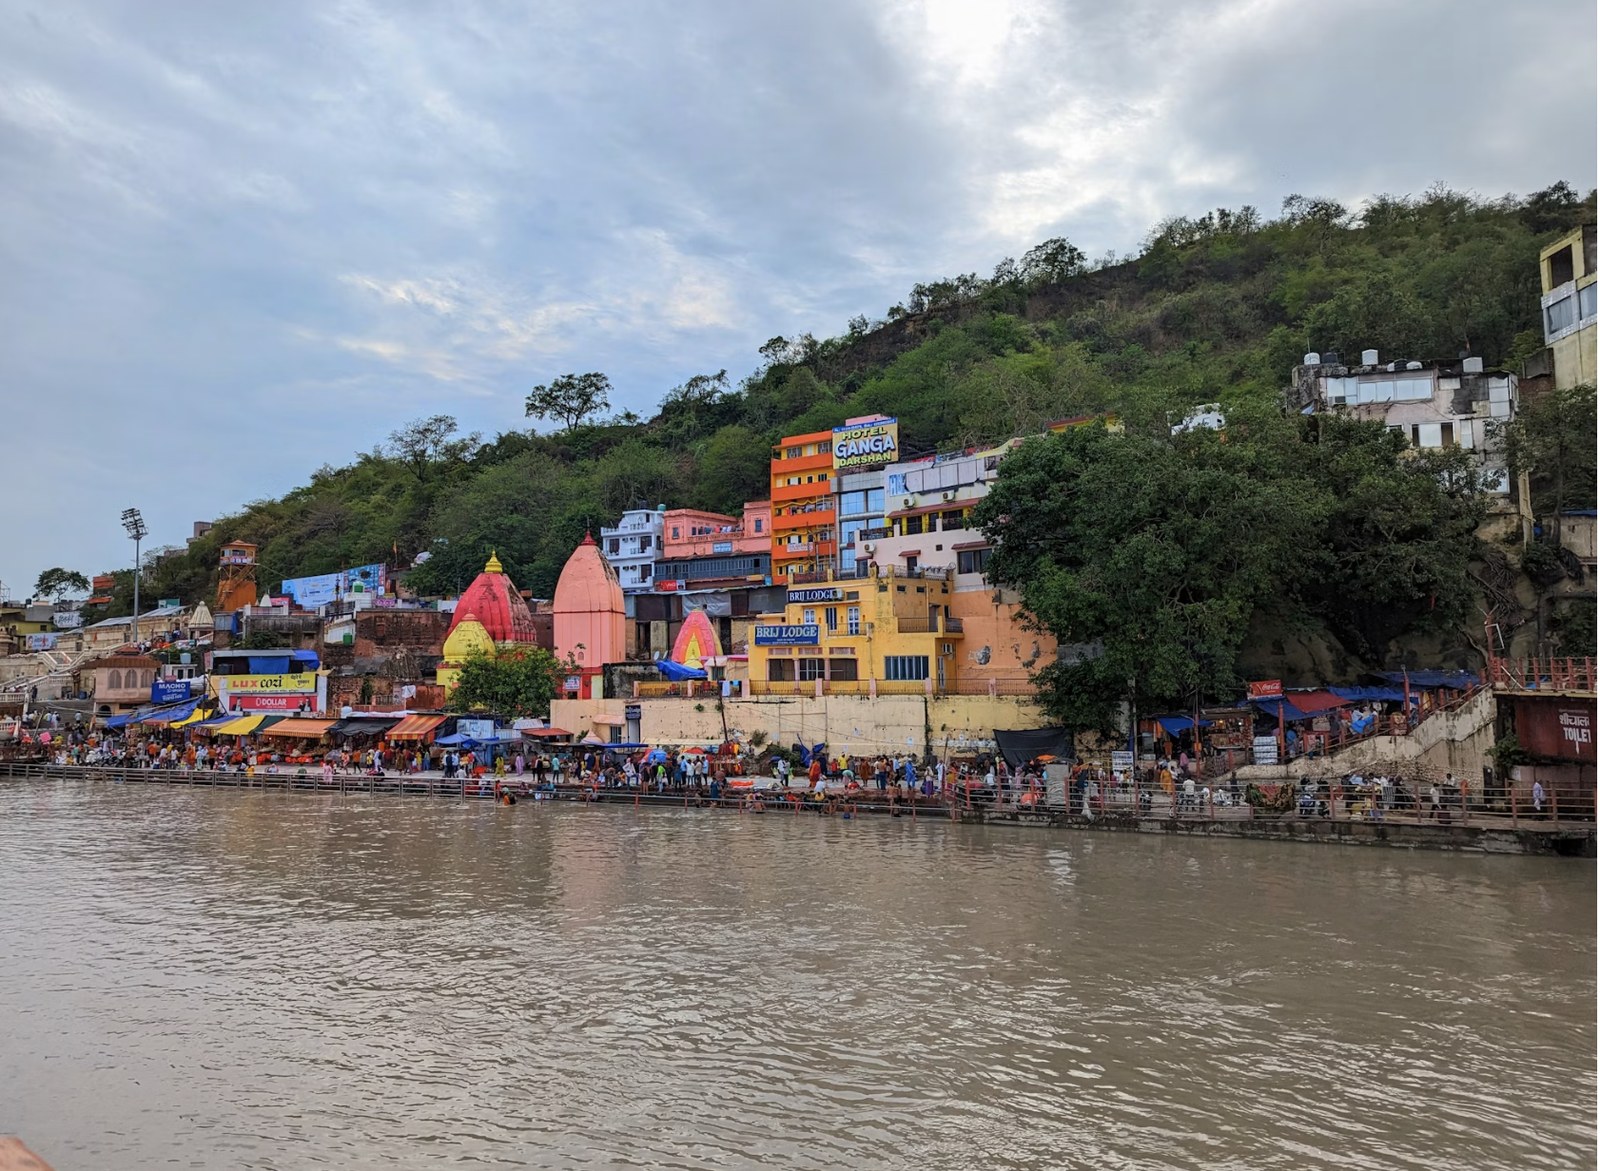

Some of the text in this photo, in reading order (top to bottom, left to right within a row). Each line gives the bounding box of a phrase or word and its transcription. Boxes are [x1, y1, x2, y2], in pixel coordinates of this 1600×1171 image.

[842, 427, 888, 441] HOTEL
[835, 434, 896, 459] GANGA
[839, 452, 891, 468] DARSHAN
[789, 591, 805, 601] BRIJ
[756, 626, 817, 637] BRIJ LODGE
